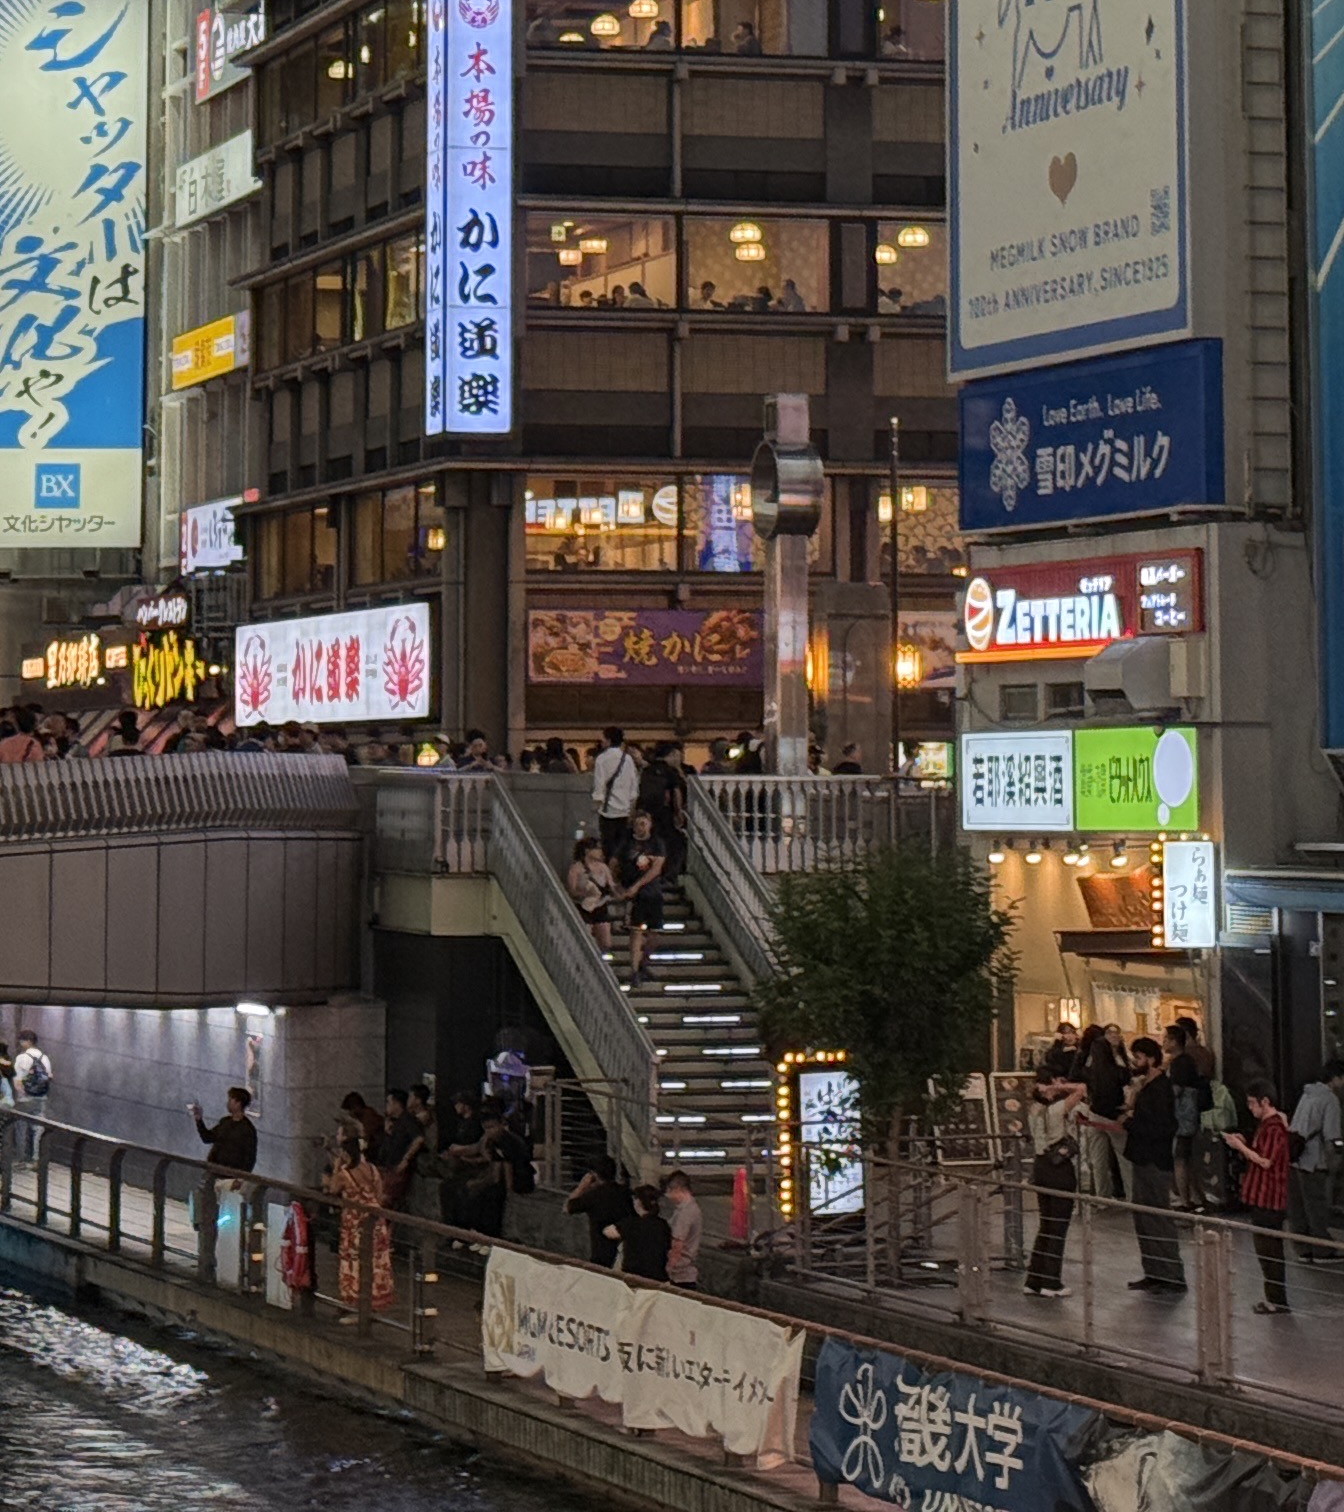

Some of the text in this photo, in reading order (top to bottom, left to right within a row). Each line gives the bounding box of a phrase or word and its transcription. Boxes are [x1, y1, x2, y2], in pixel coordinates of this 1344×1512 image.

[459, 41, 497, 192] 本場の味
[1002, 64, 1129, 135] Anniversary
[1050, 227, 1089, 257] SNOW
[1093, 215, 1140, 246] BRAND
[457, 206, 501, 418] かに道楽
[1042, 401, 1068, 428] Love
[1107, 390, 1134, 417] Love
[40, 474, 76, 498] BX
[1035, 427, 1172, 497] 雪印メグミルク
[996, 589, 1121, 645] ZETTERIA
[1168, 884, 1189, 943] つけ麺
